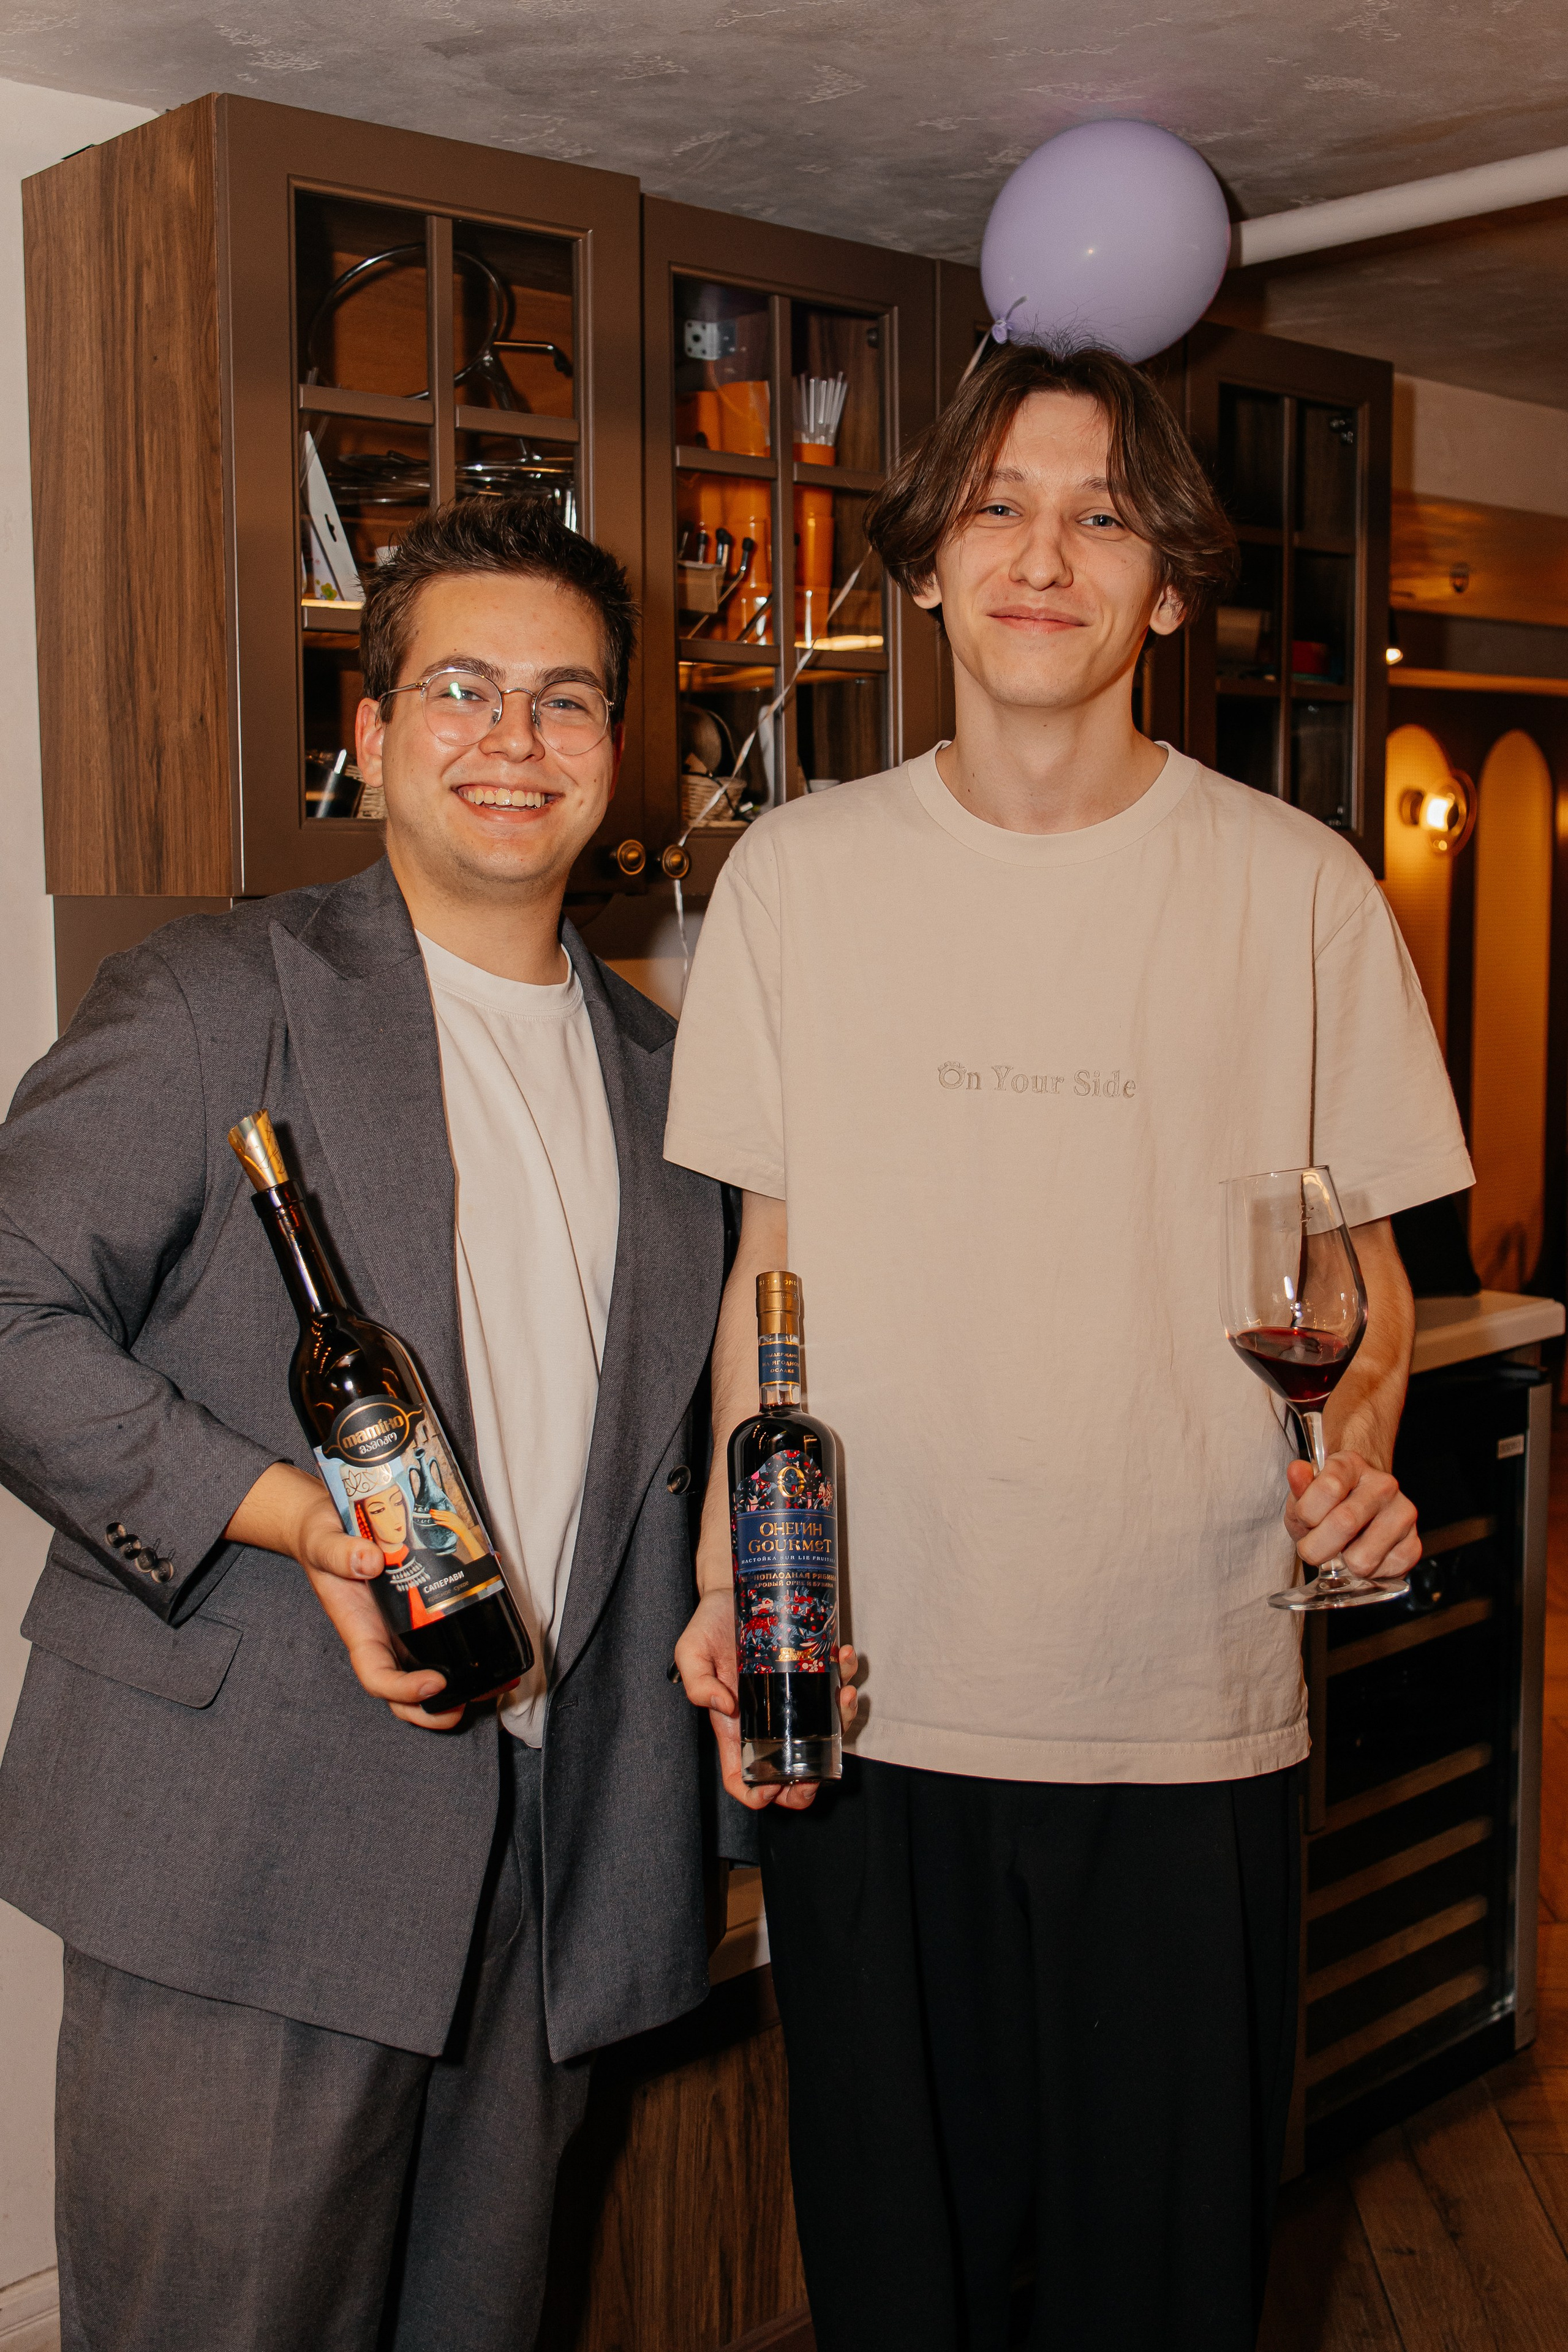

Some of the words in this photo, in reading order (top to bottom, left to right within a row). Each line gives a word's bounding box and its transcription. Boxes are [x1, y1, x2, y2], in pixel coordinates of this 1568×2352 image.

[937, 1061, 982, 1090] On
[991, 1065, 1065, 1094] Your
[1072, 1069, 1137, 1099] Side
[760, 1521, 823, 1537] ОНЕГИН
[741, 1556, 777, 1564] НАСТОЙКА
[423, 1570, 464, 1594] САПЕРАВИ
[812, 1573, 837, 1581] РЯБИНА
